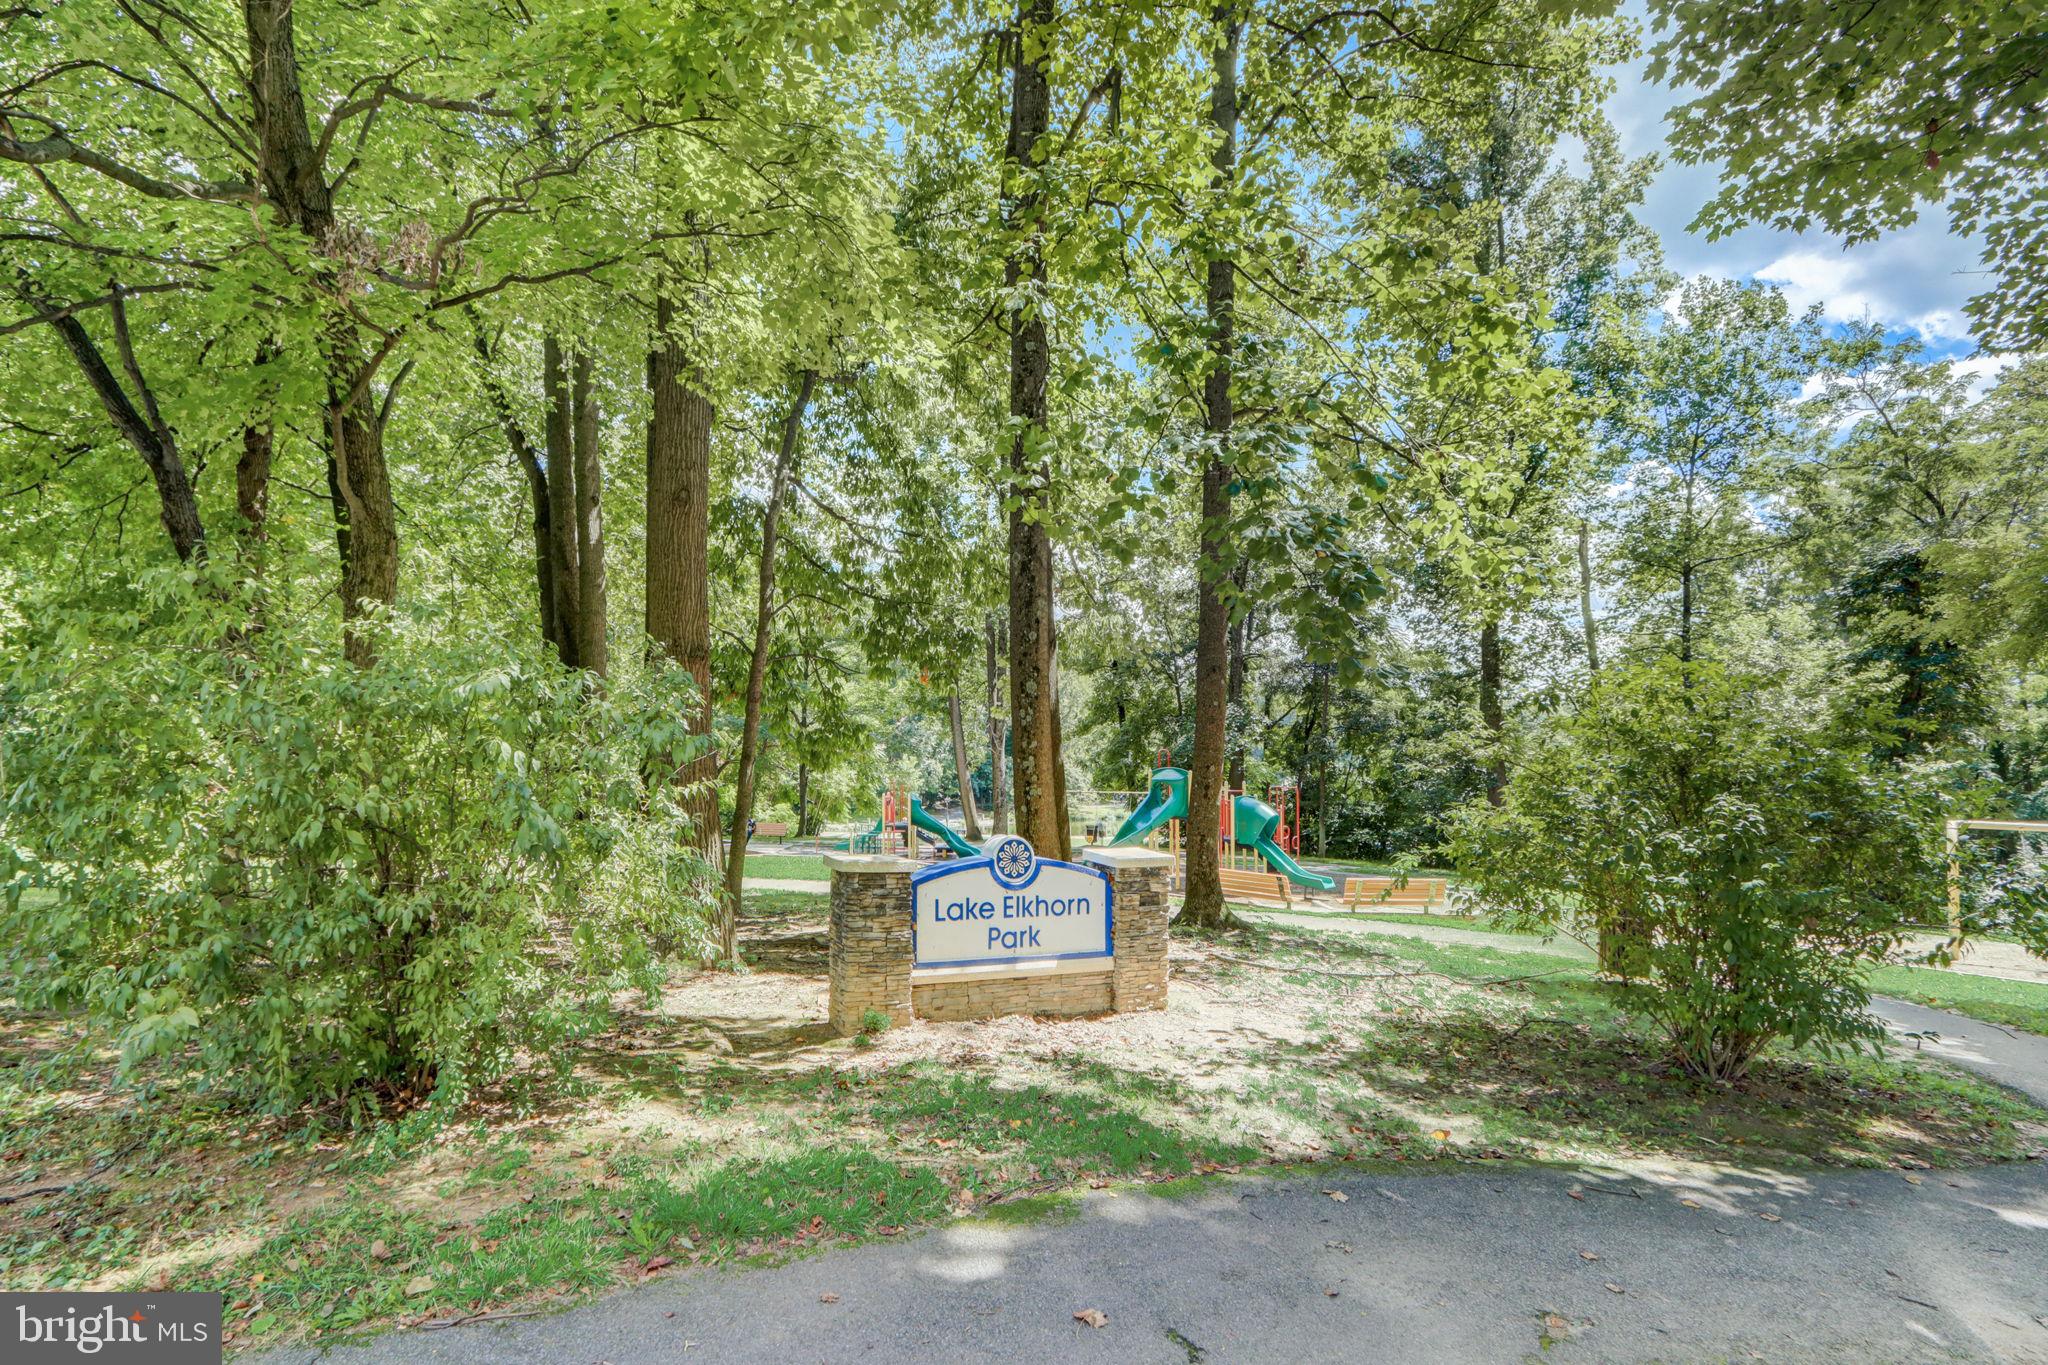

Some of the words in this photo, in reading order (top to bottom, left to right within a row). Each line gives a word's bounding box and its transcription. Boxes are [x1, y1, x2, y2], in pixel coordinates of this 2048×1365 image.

[935, 897, 995, 922] Lake
[1003, 894, 1090, 919] Elkhorn
[987, 925, 1041, 950] Park
